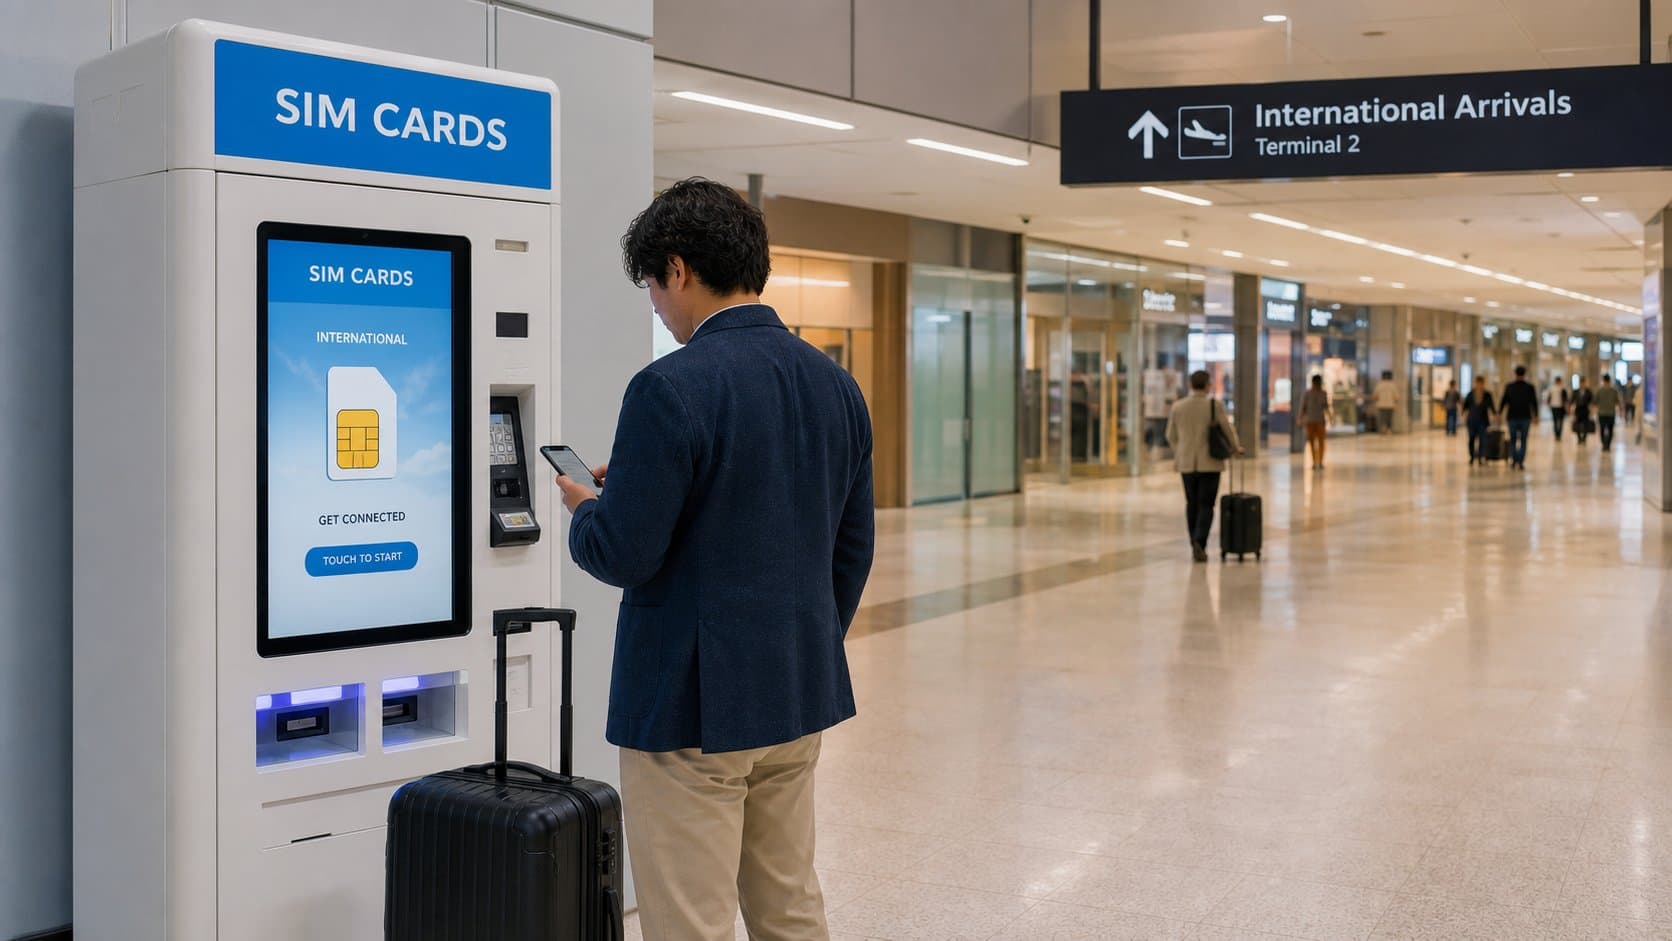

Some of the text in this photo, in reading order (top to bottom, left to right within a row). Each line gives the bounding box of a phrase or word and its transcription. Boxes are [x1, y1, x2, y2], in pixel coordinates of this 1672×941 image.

[275, 88, 508, 151] SIM CARDS
[1256, 89, 1573, 128] International Arrivals
[1256, 134, 1361, 156] Terminal 2
[309, 265, 414, 287] SIM CARDS
[316, 331, 408, 345] INTERNATIONAL
[318, 511, 406, 526] GET CONNECTED
[323, 551, 403, 565] TOUCH TO START
